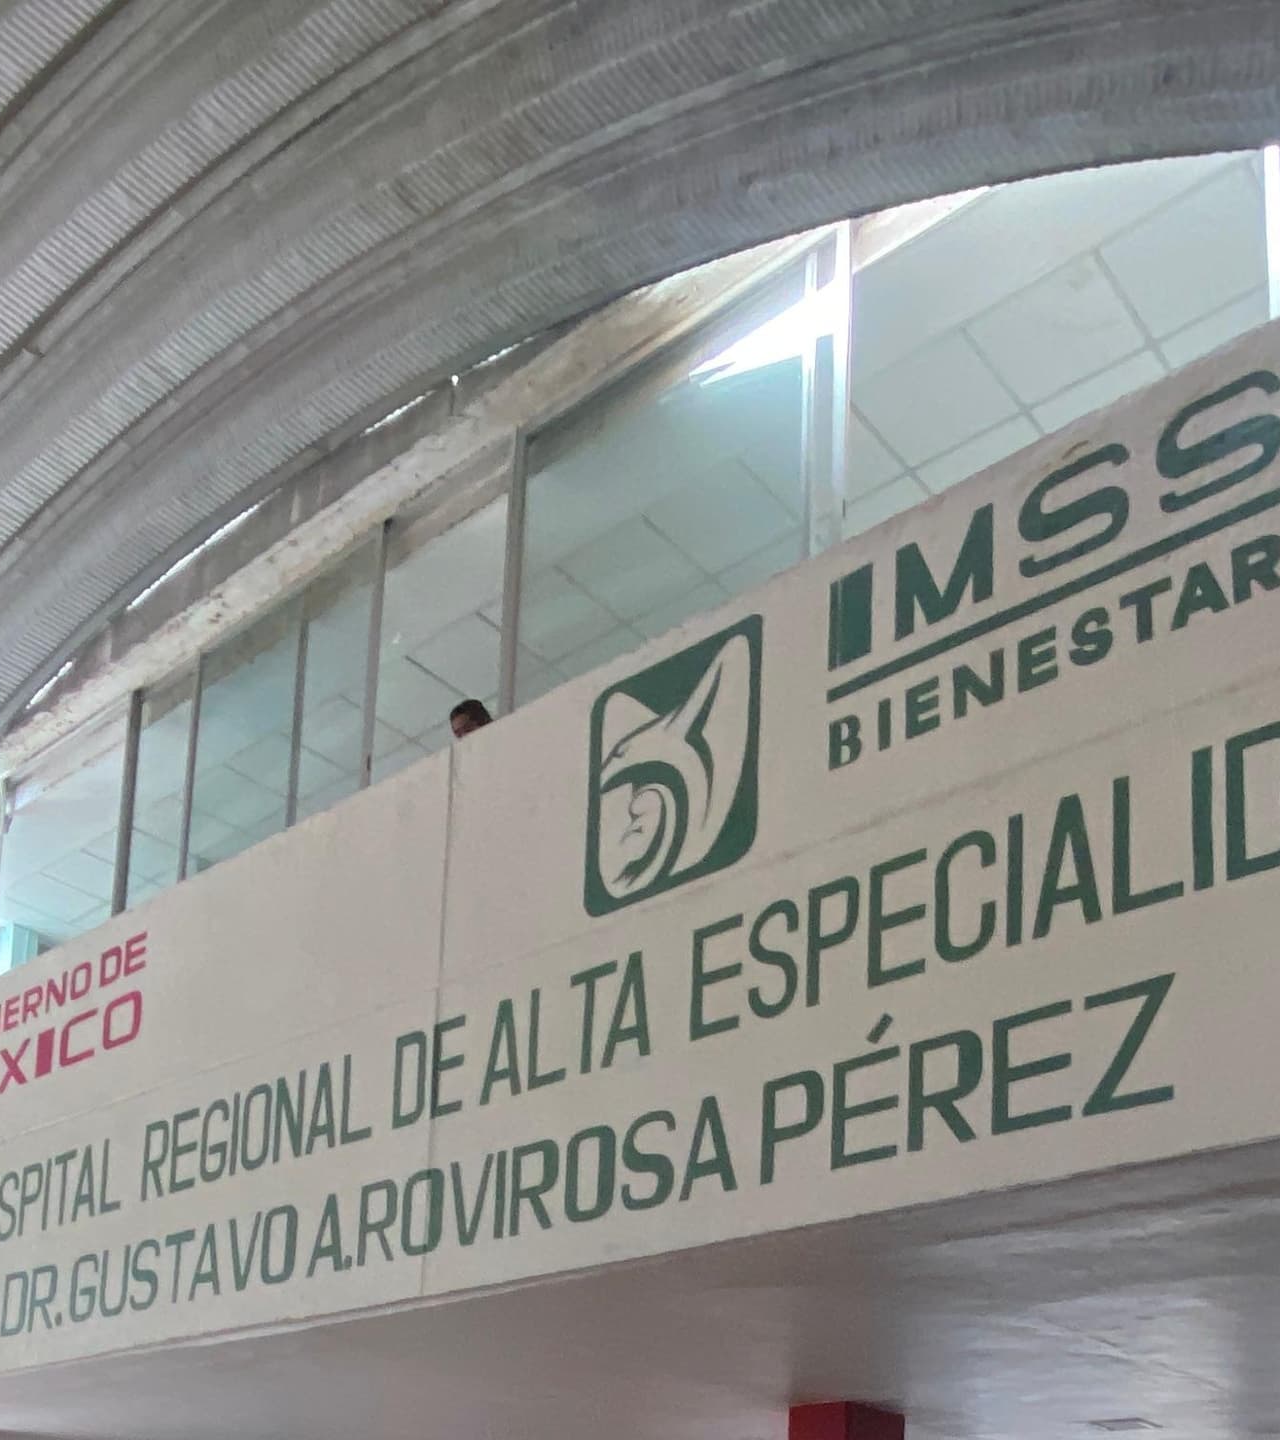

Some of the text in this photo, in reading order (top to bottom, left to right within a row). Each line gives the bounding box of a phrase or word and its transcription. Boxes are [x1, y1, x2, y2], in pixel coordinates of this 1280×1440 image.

[99, 931, 148, 988] DE
[140, 1054, 372, 1202] REGIONAL
[392, 1014, 466, 1130] DE
[479, 951, 650, 1105] ALTA
[760, 972, 1176, 1186] PÉREZ
